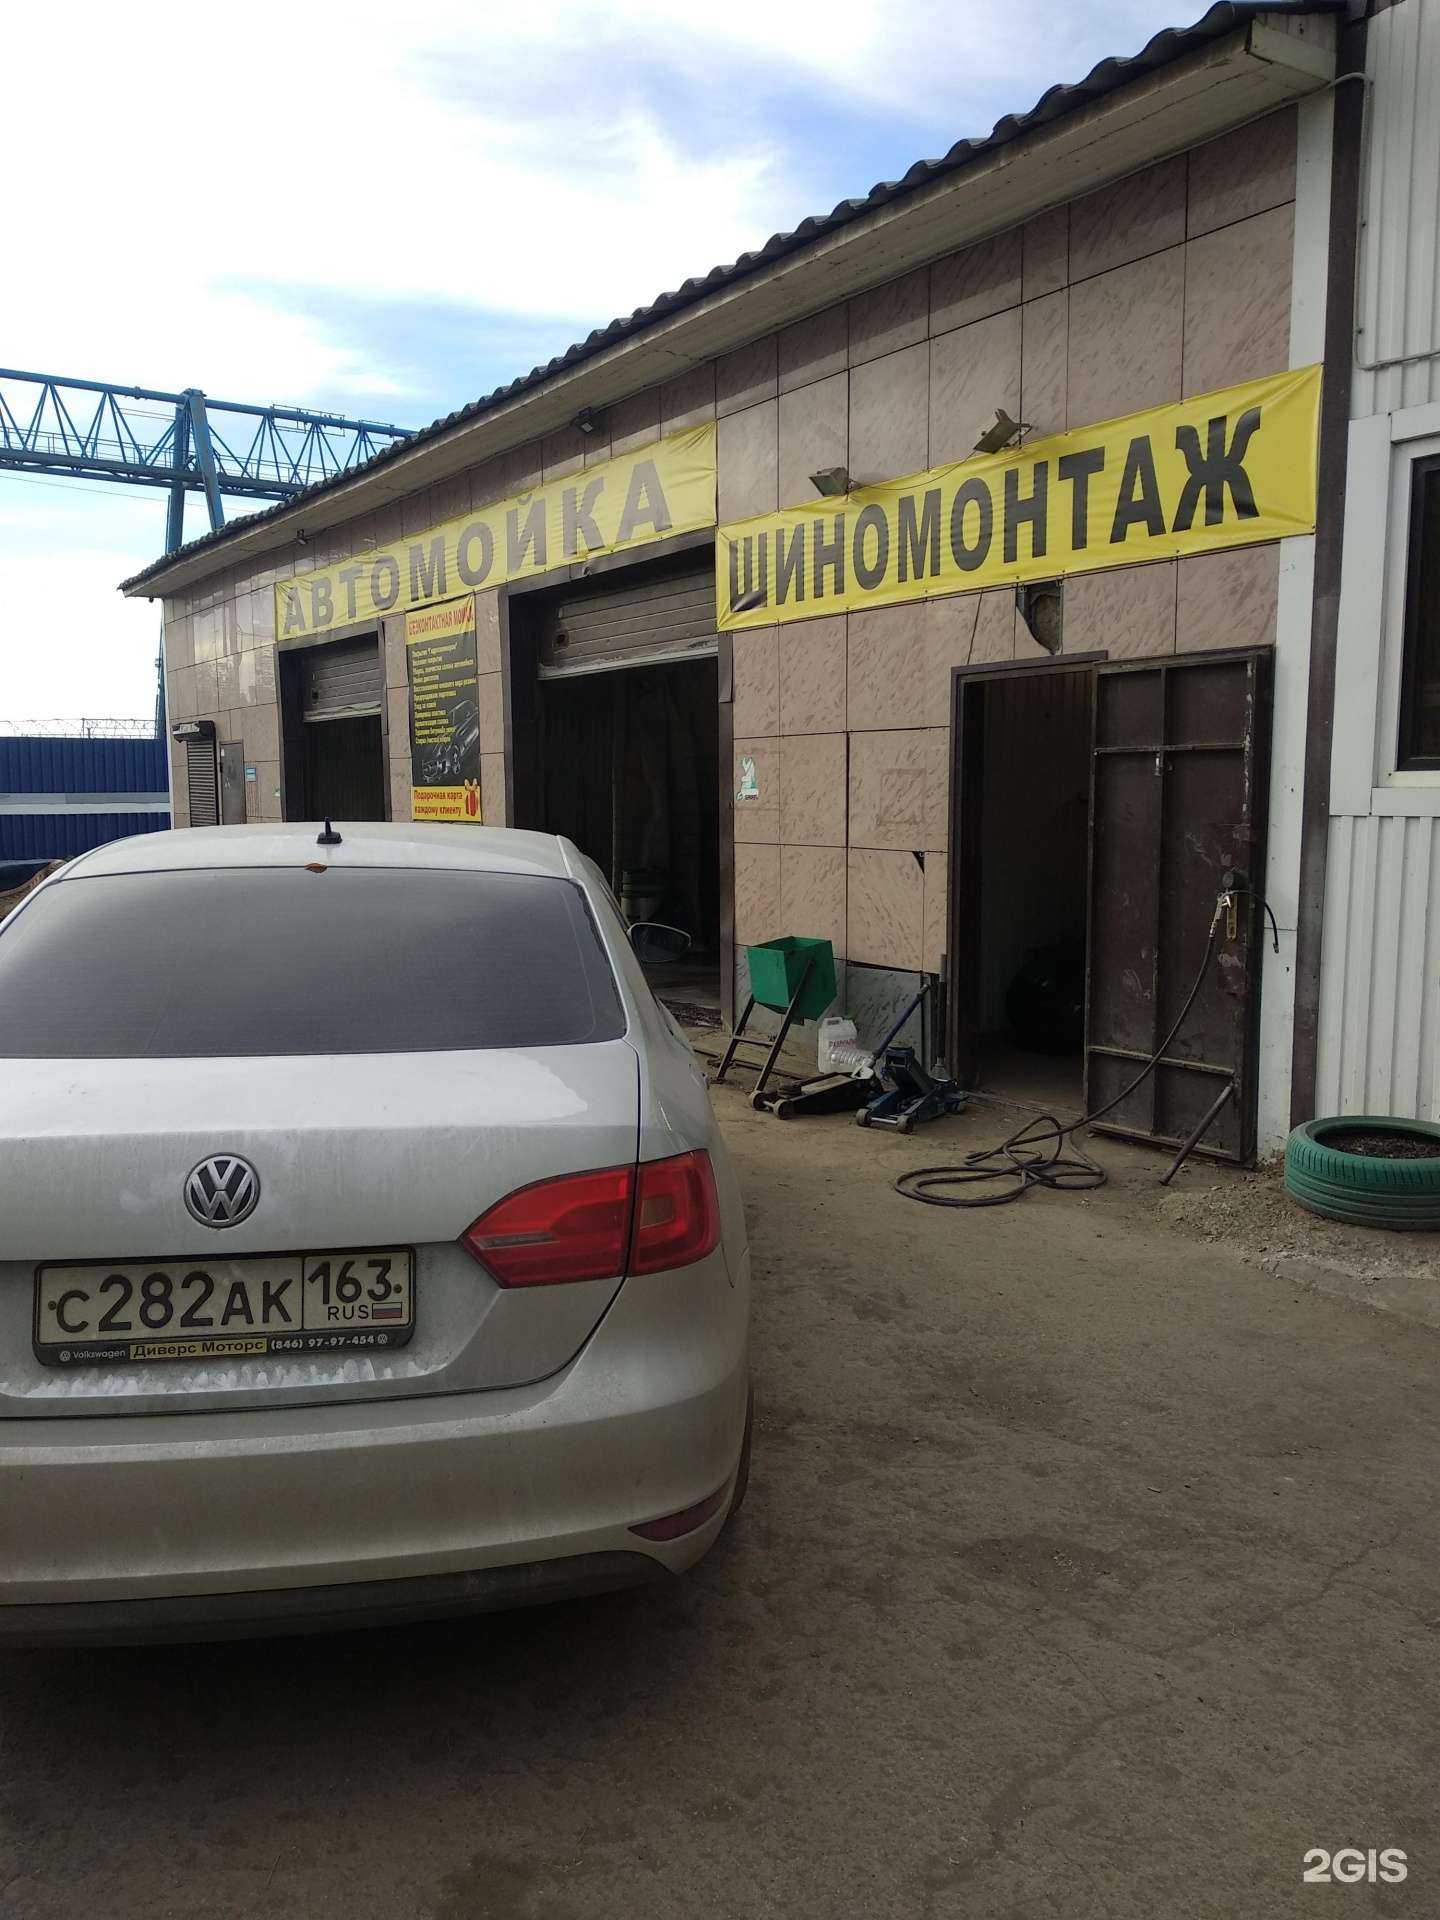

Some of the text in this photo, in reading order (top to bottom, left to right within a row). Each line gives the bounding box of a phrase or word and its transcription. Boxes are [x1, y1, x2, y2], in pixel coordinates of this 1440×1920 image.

[729, 406, 1262, 613] ШИНОМОНТАЖ
[282, 458, 673, 635] АВТОМОЙКА
[447, 791, 463, 802] карта
[308, 1259, 392, 1305] 163
[327, 1304, 370, 1321] RUS
[133, 1341, 264, 1358] Диверс Моторс
[271, 1338, 303, 1350] (846)
[73, 1349, 126, 1361] Volkswagen
